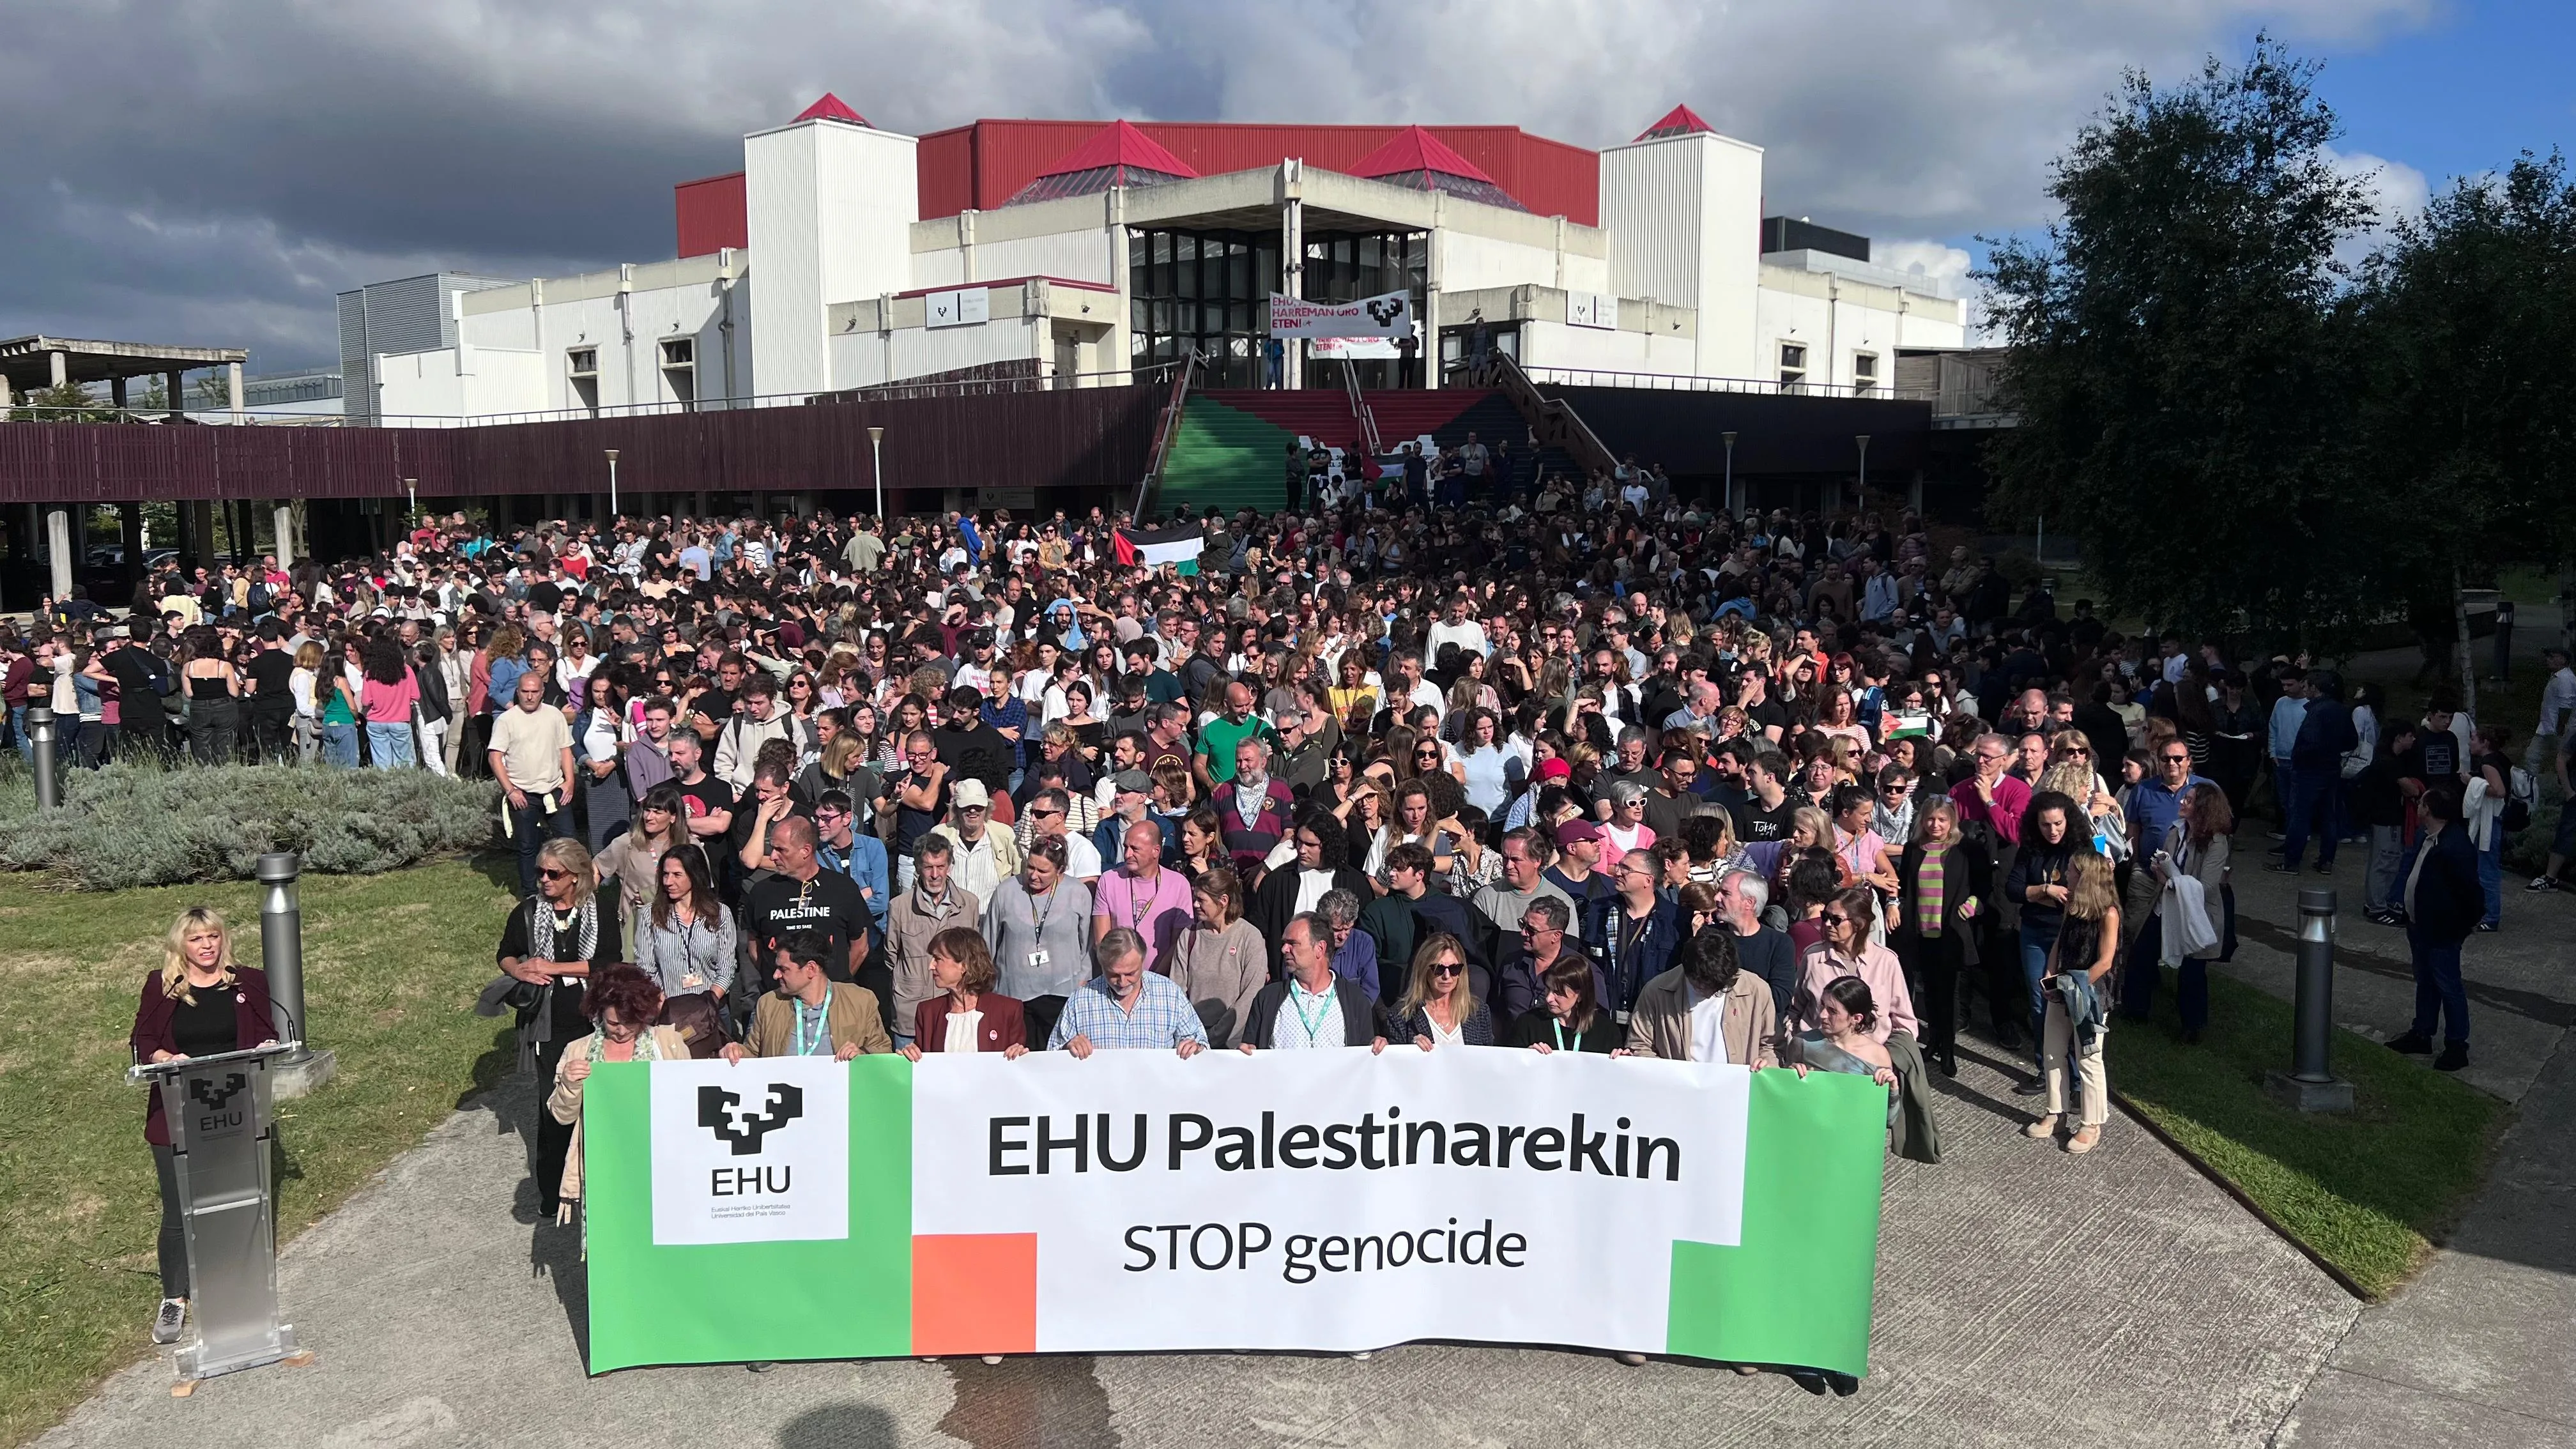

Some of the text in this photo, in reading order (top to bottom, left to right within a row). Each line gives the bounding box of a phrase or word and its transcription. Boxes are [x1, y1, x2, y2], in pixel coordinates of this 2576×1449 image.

[1272, 307, 1333, 318] HARREMAN
[1753, 821, 1778, 837] Tokyo
[770, 907, 830, 920] PALESTINE
[201, 1112, 242, 1131] EHU
[990, 1105, 1680, 1181] EHU Palestinarekin
[712, 1166, 790, 1196] EHU
[1123, 1218, 1527, 1284] STOP genocide
